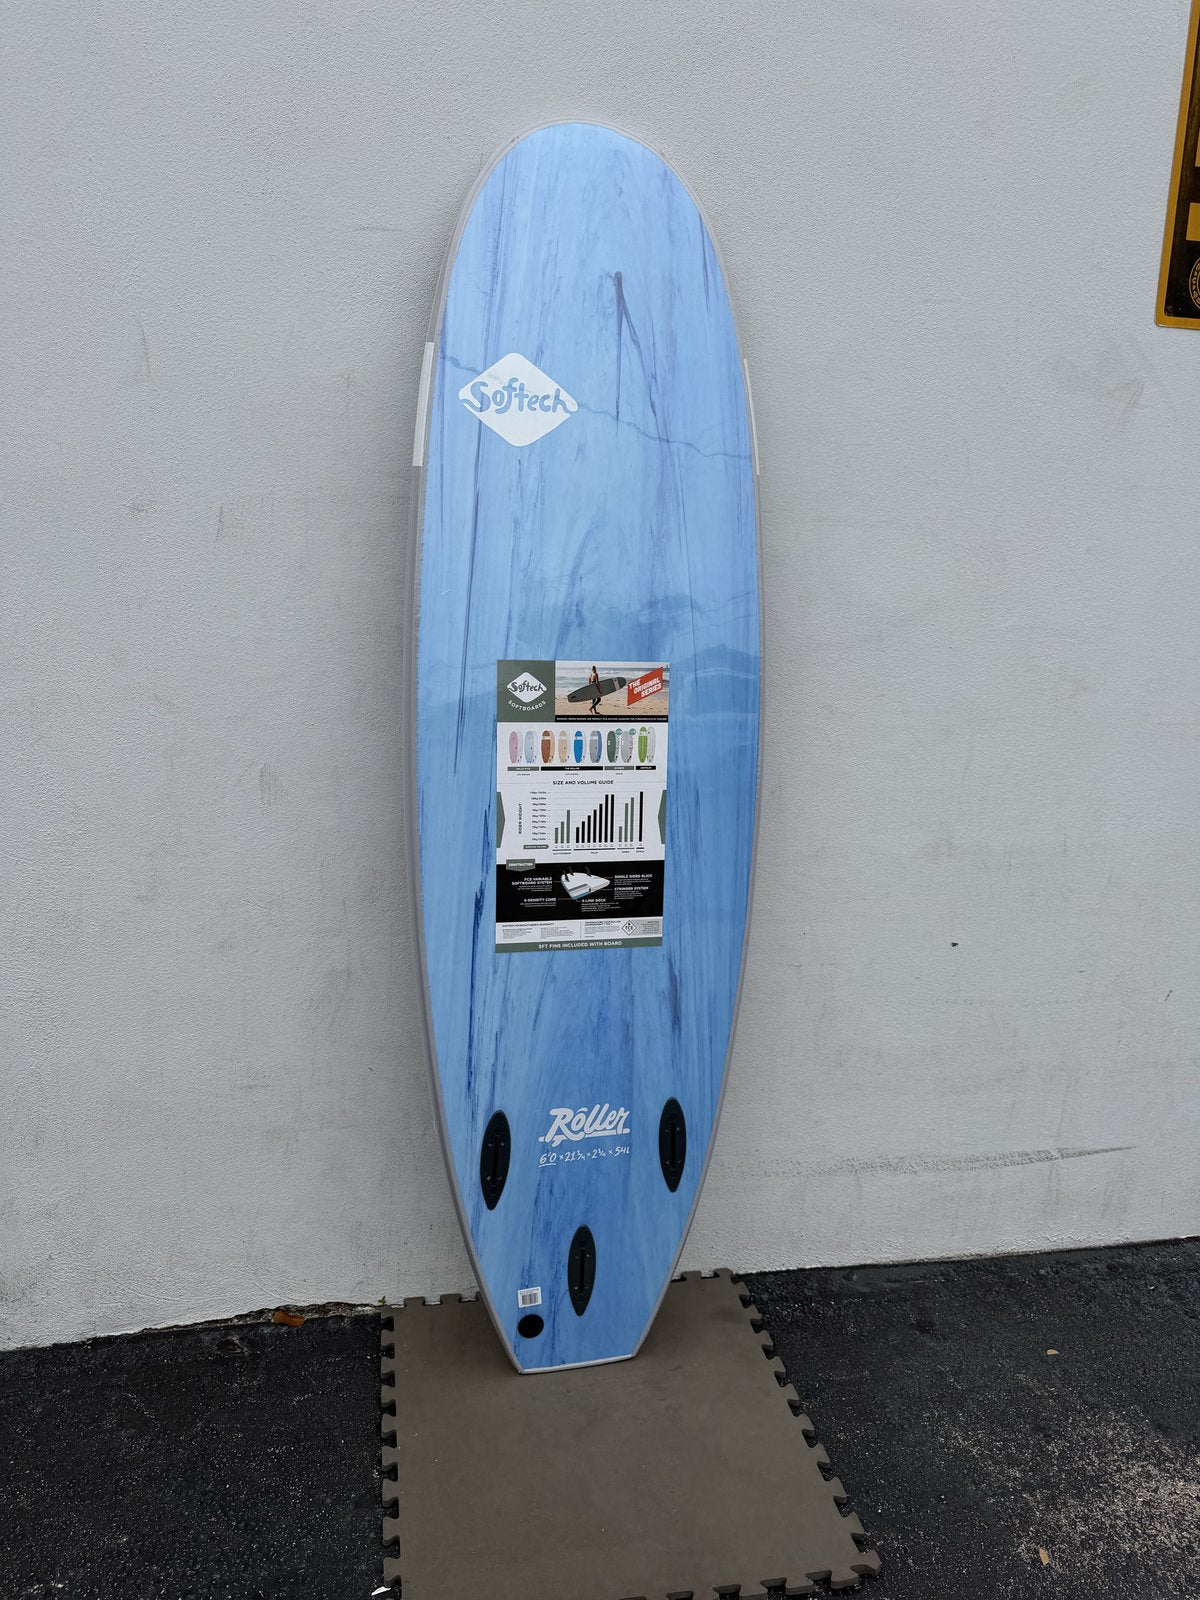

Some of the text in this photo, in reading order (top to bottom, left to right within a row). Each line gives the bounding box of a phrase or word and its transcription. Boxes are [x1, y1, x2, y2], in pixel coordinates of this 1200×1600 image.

[460, 377, 578, 415] Softech
[508, 680, 546, 693] Softech
[629, 679, 641, 690] THE
[633, 677, 661, 694] ORIGINAL
[641, 682, 662, 698] SERIES
[508, 700, 547, 711] SOFTBOARDS
